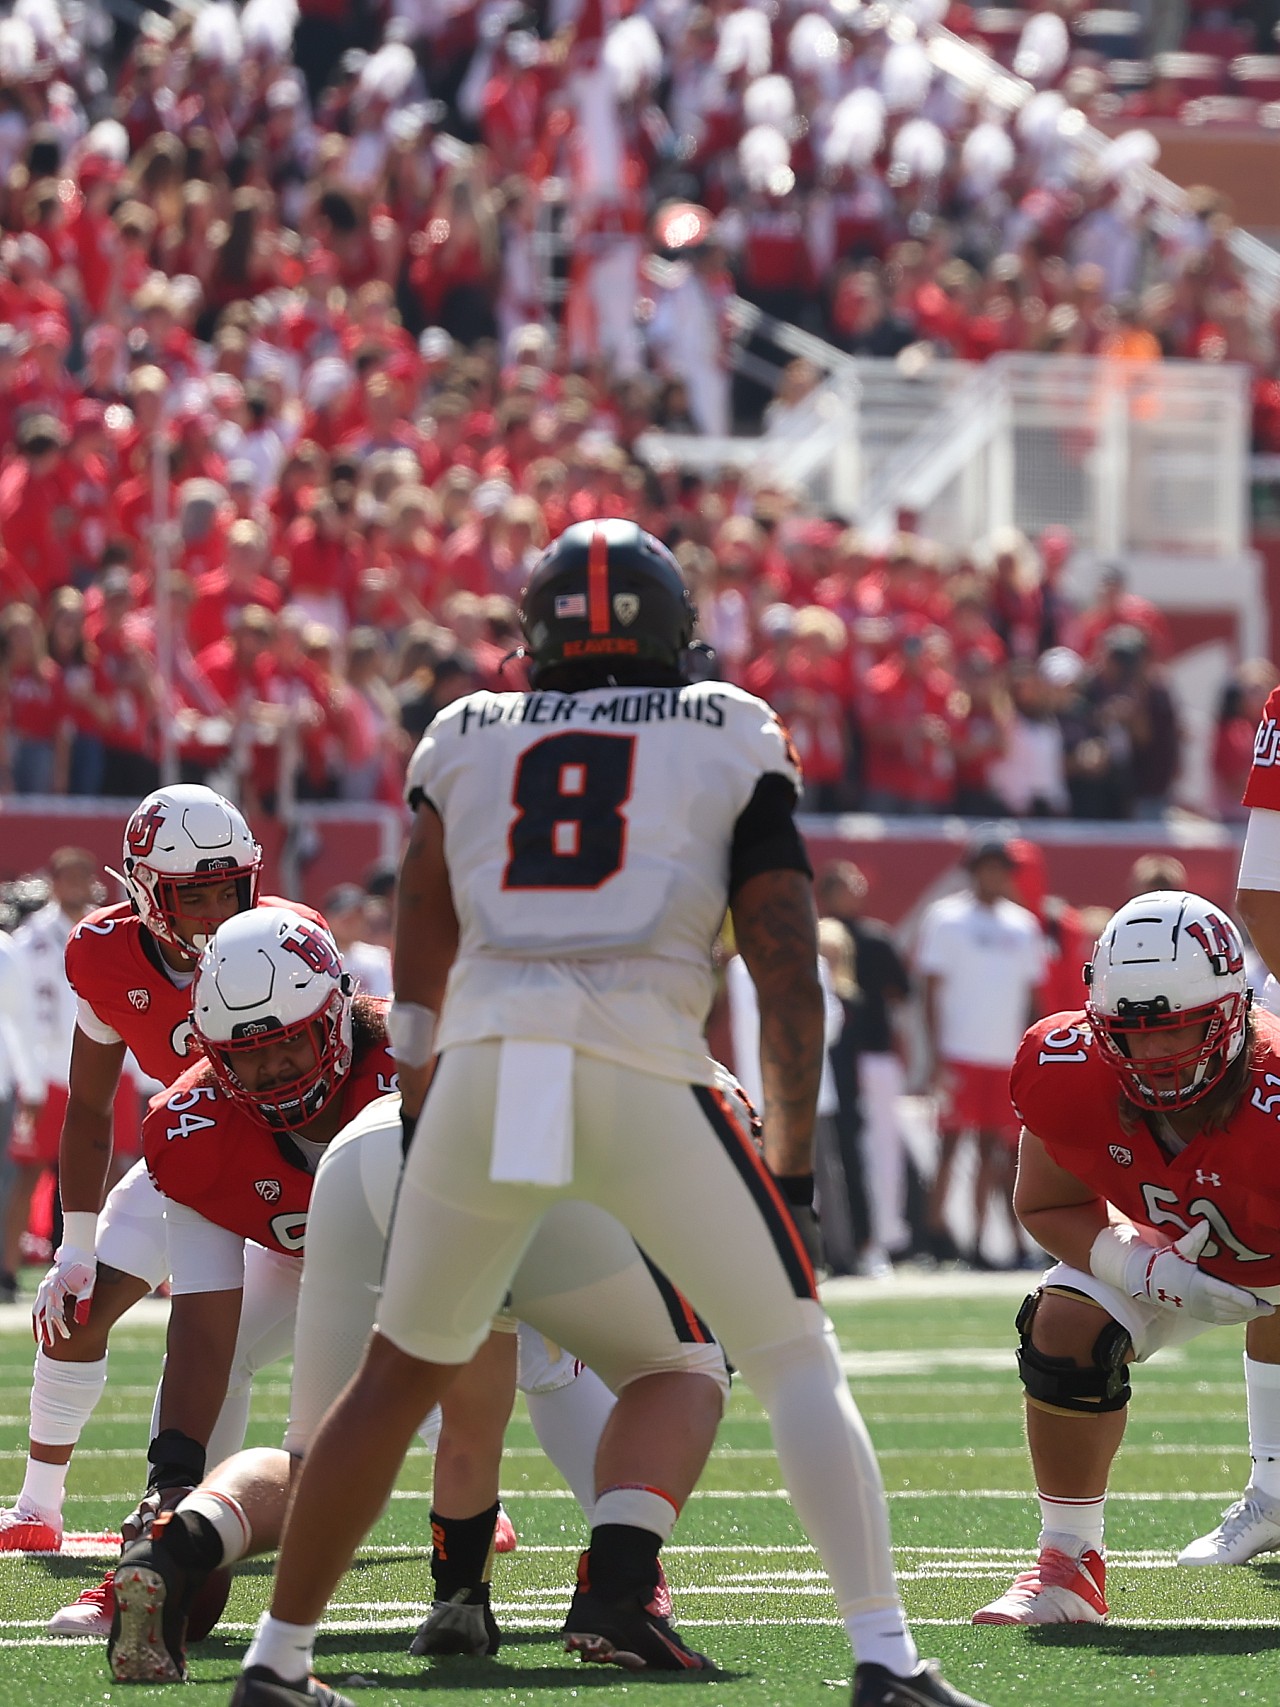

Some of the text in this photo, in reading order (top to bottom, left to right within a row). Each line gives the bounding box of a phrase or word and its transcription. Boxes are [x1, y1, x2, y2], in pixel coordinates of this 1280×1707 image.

[461, 690, 726, 736] FISHER-MORRIS
[501, 729, 637, 892] 8
[75, 919, 116, 940] 2
[1038, 1026, 1094, 1066] 51
[166, 1086, 217, 1141] 54
[1140, 1182, 1274, 1262] 51
